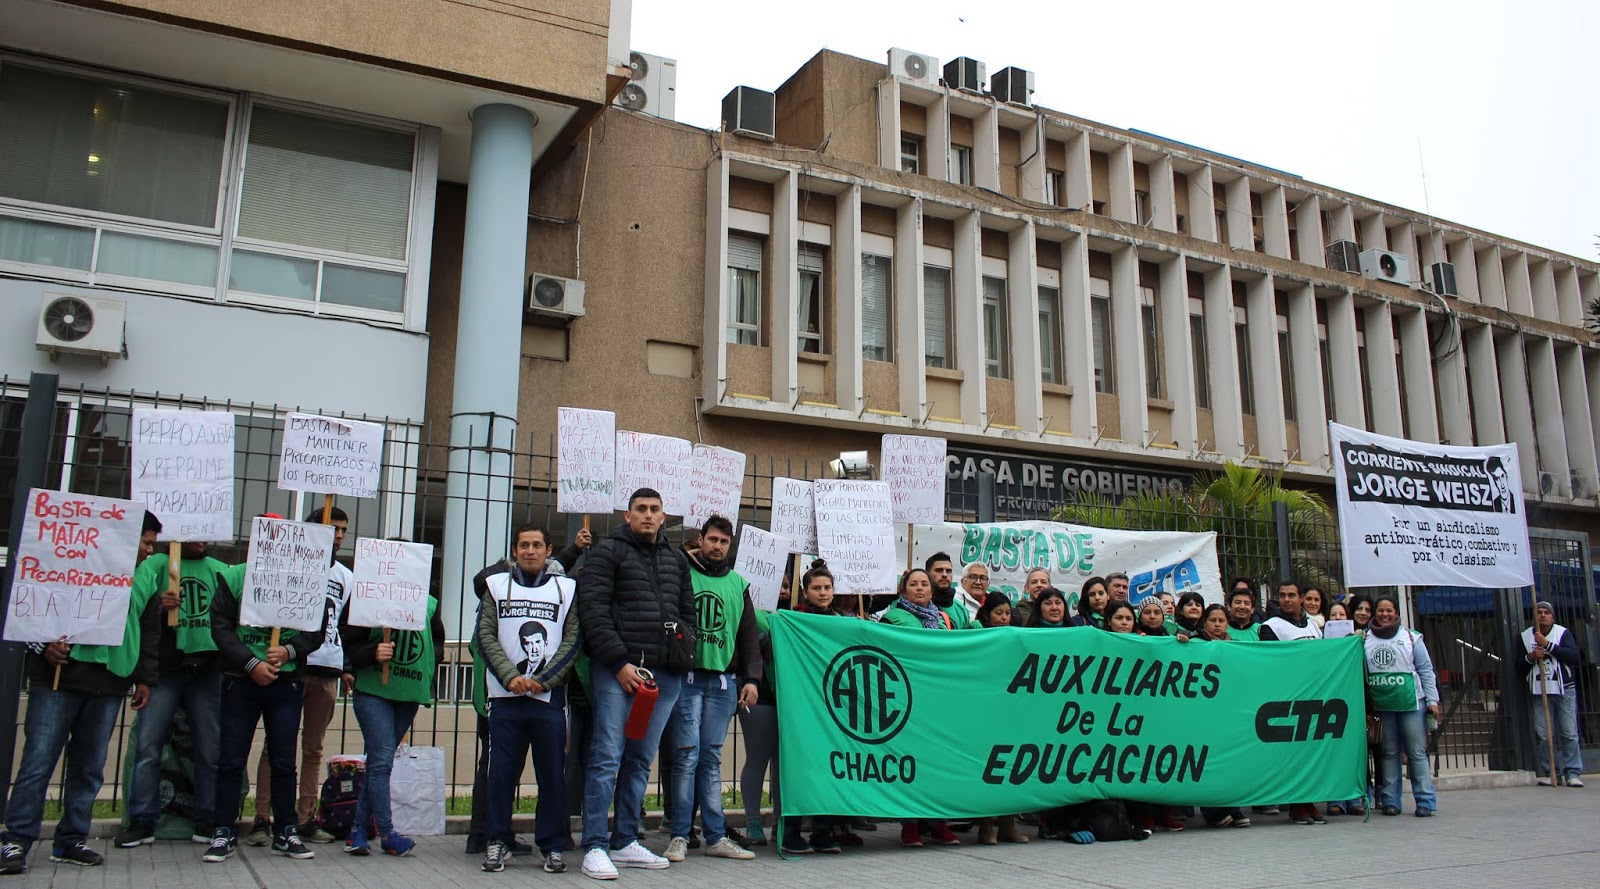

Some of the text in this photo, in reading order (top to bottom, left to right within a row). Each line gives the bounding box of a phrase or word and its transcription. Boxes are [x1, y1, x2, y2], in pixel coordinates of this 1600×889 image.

[139, 418, 193, 446] PEPPO
[884, 437, 928, 452] CONTRA
[306, 436, 368, 454] MANTENER
[155, 457, 225, 480] REPRIME
[369, 461, 379, 473] A
[945, 455, 1184, 497] CASA DE GOBIERNO
[1346, 450, 1488, 479] CORRIENTE SINDICAL
[305, 470, 354, 488] PORTEROS
[786, 483, 801, 499] NO
[1353, 472, 1493, 506] JORGE WEISZ
[38, 521, 99, 549] MATAR
[1416, 521, 1431, 532] un
[1436, 520, 1500, 536] sindicalismo
[360, 539, 405, 559] BASTA
[960, 523, 1096, 576] BASTA DE
[1412, 551, 1432, 563] por
[378, 561, 397, 576] DE
[745, 556, 776, 581] PLANTA
[1128, 557, 1202, 605] CTA
[356, 581, 422, 602] DESPIDO
[529, 609, 555, 620] WEISZ
[392, 666, 423, 681] CHACO
[1006, 652, 1221, 699] AUXILIARES
[832, 655, 901, 734] ATE
[1056, 701, 1144, 736] De La
[1255, 698, 1349, 743] CTA
[829, 751, 916, 784] CHACO
[982, 743, 1209, 785] EDUCACION
